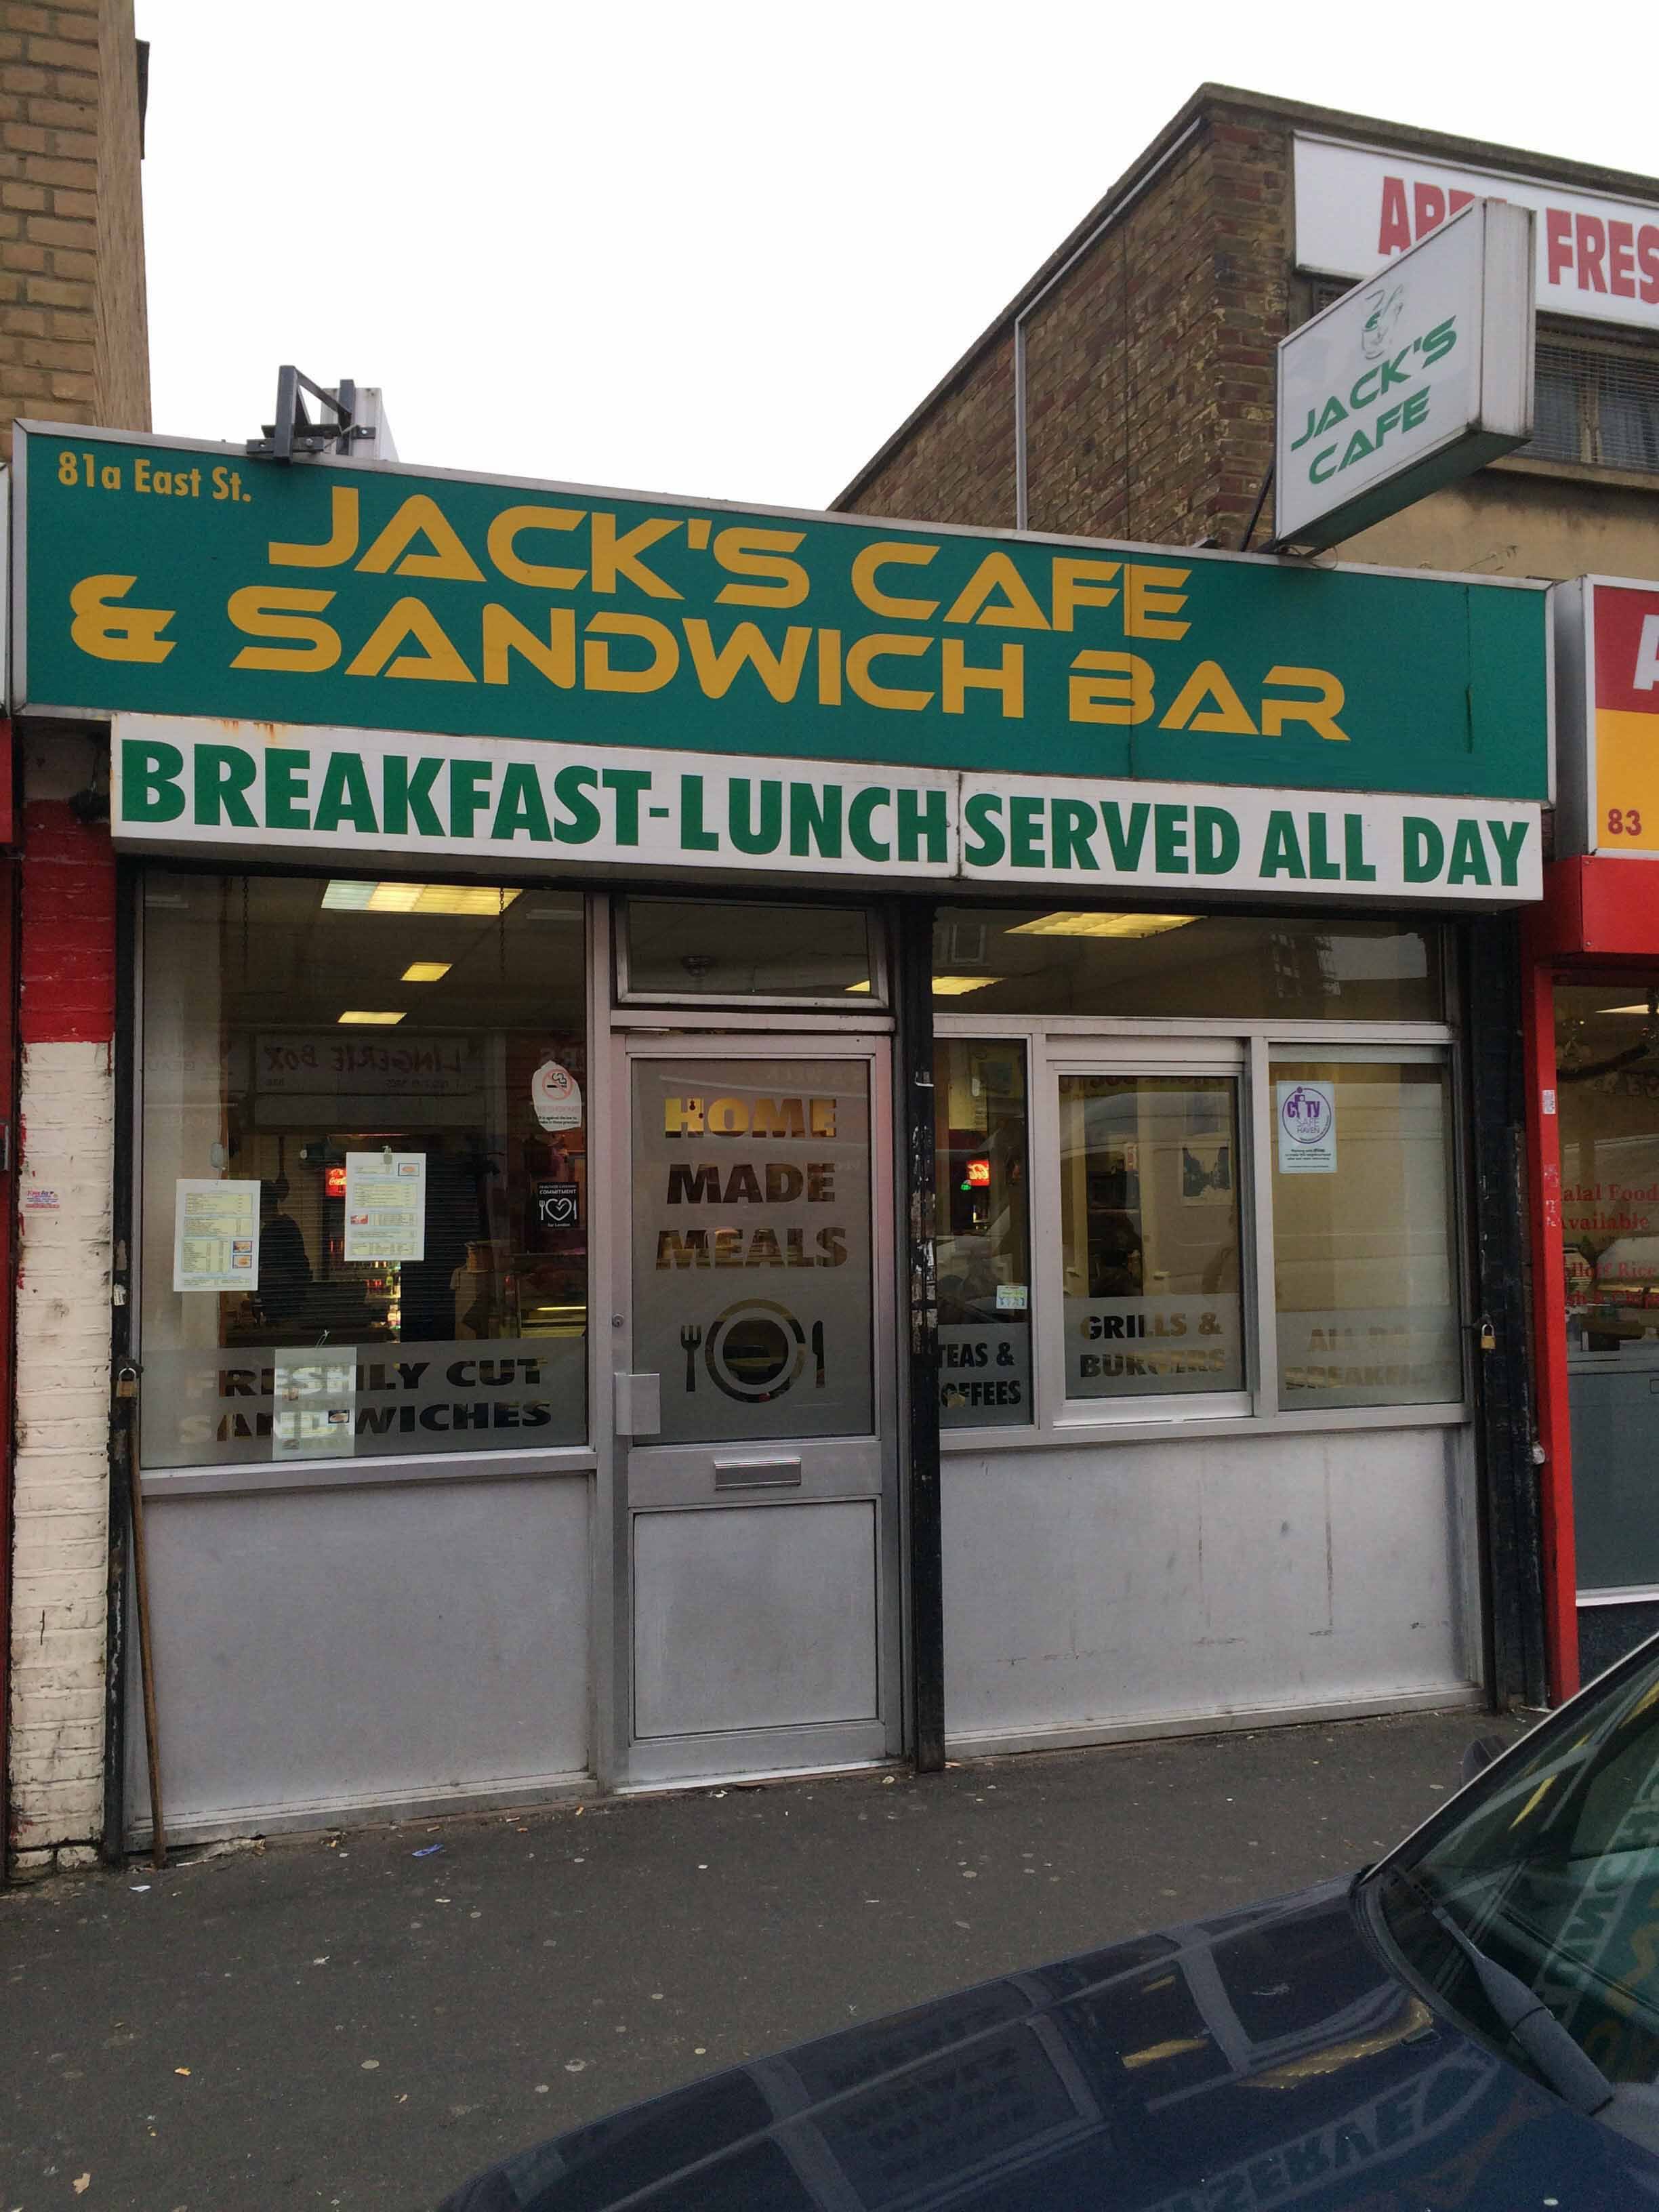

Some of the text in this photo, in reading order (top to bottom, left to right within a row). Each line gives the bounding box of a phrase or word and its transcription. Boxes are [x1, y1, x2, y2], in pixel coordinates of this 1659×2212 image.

[1290, 314, 1458, 452] JACK'S
[1309, 385, 1431, 484] CAFE
[57, 451, 252, 504] 81a East St.
[268, 485, 1193, 641] JACK'S CAFE
[70, 574, 1351, 741] & SANDWICH BAR
[964, 792, 1241, 876] SERVED
[1258, 810, 1377, 882] ALL
[1403, 816, 1530, 887] DAY
[1607, 808, 1642, 836] 83
[664, 1097, 837, 1139] HOME
[667, 1162, 836, 1204] MADE
[1560, 1182, 1602, 1202] alal
[655, 1227, 848, 1271] MEALS
[1080, 1311, 1187, 1340] GRILLS
[446, 1356, 548, 1387] CUT
[996, 1342, 1015, 1367] &
[935, 1380, 1022, 1408] OFFEES
